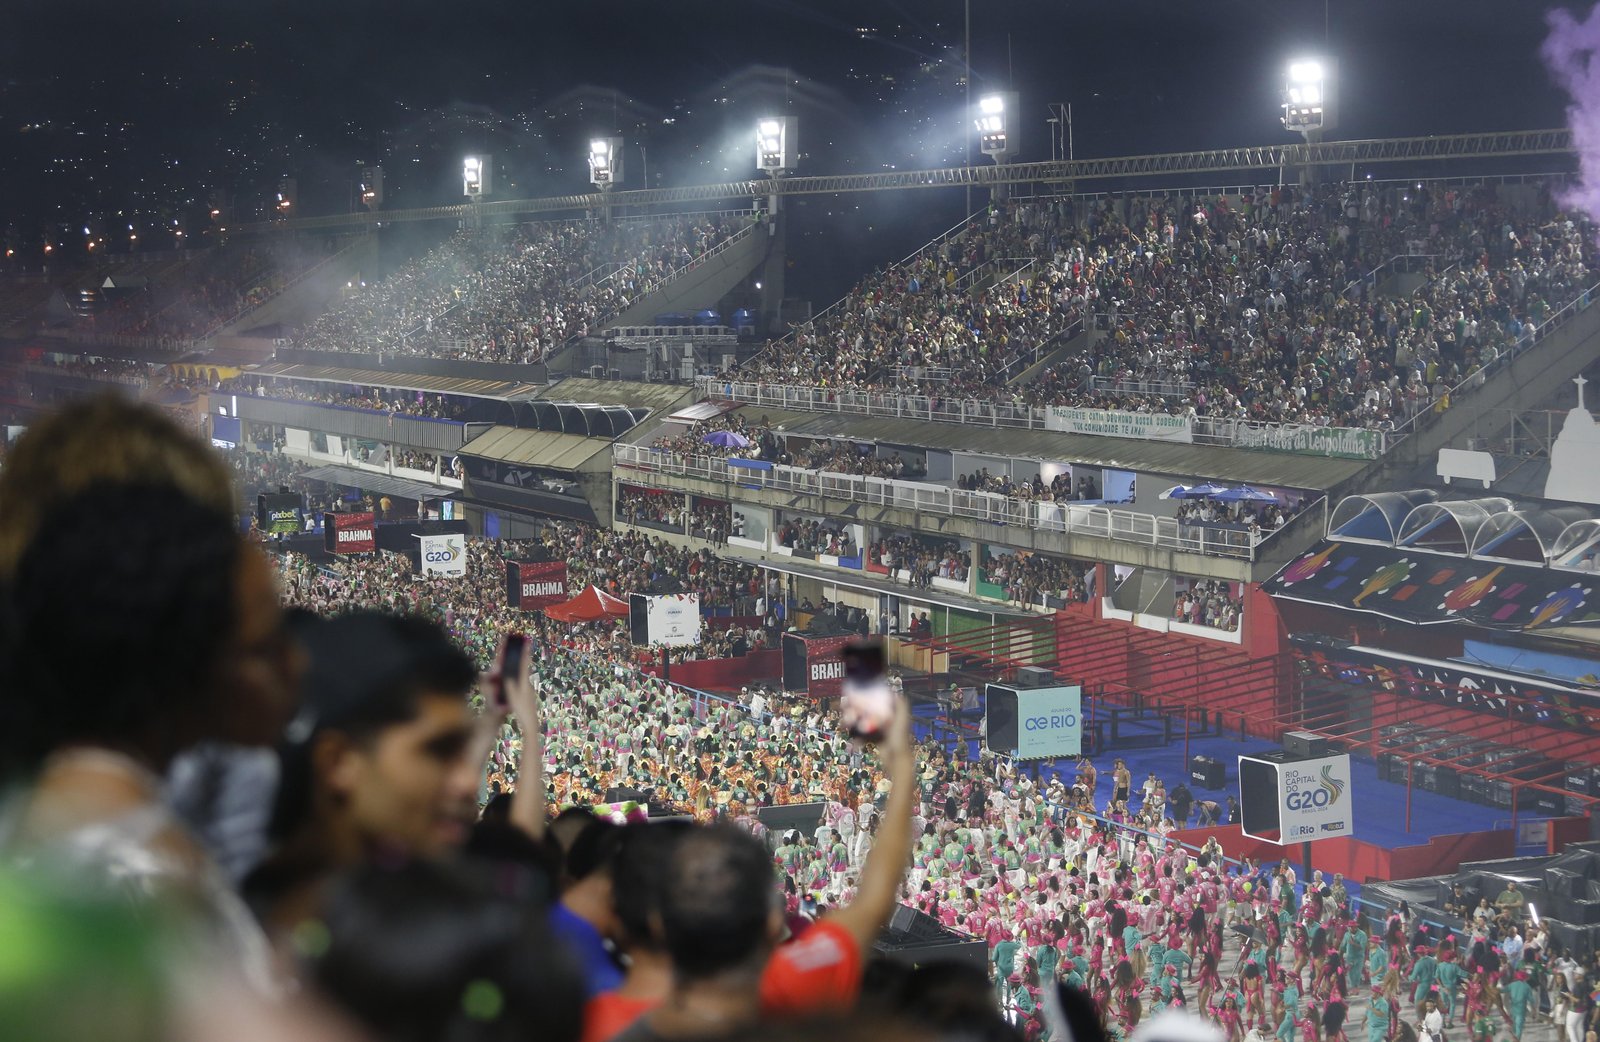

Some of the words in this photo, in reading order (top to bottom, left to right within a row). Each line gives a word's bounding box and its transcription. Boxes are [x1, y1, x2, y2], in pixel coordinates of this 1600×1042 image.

[1084, 423, 1119, 433] COMUNIDADE
[1121, 425, 1129, 434] TE
[1294, 432, 1306, 450] da
[1308, 430, 1366, 455] Leopoldina
[338, 529, 373, 542] BRAHMA
[426, 551, 452, 562] G20
[522, 582, 564, 597] BRAHMA
[811, 662, 847, 681] BRAH
[1051, 714, 1076, 729] RIO
[1285, 770, 1299, 779] RIO
[1285, 775, 1316, 786] CAPITAL
[1286, 785, 1298, 793] DO
[1286, 788, 1329, 811] G20
[1299, 825, 1315, 835] Rio
